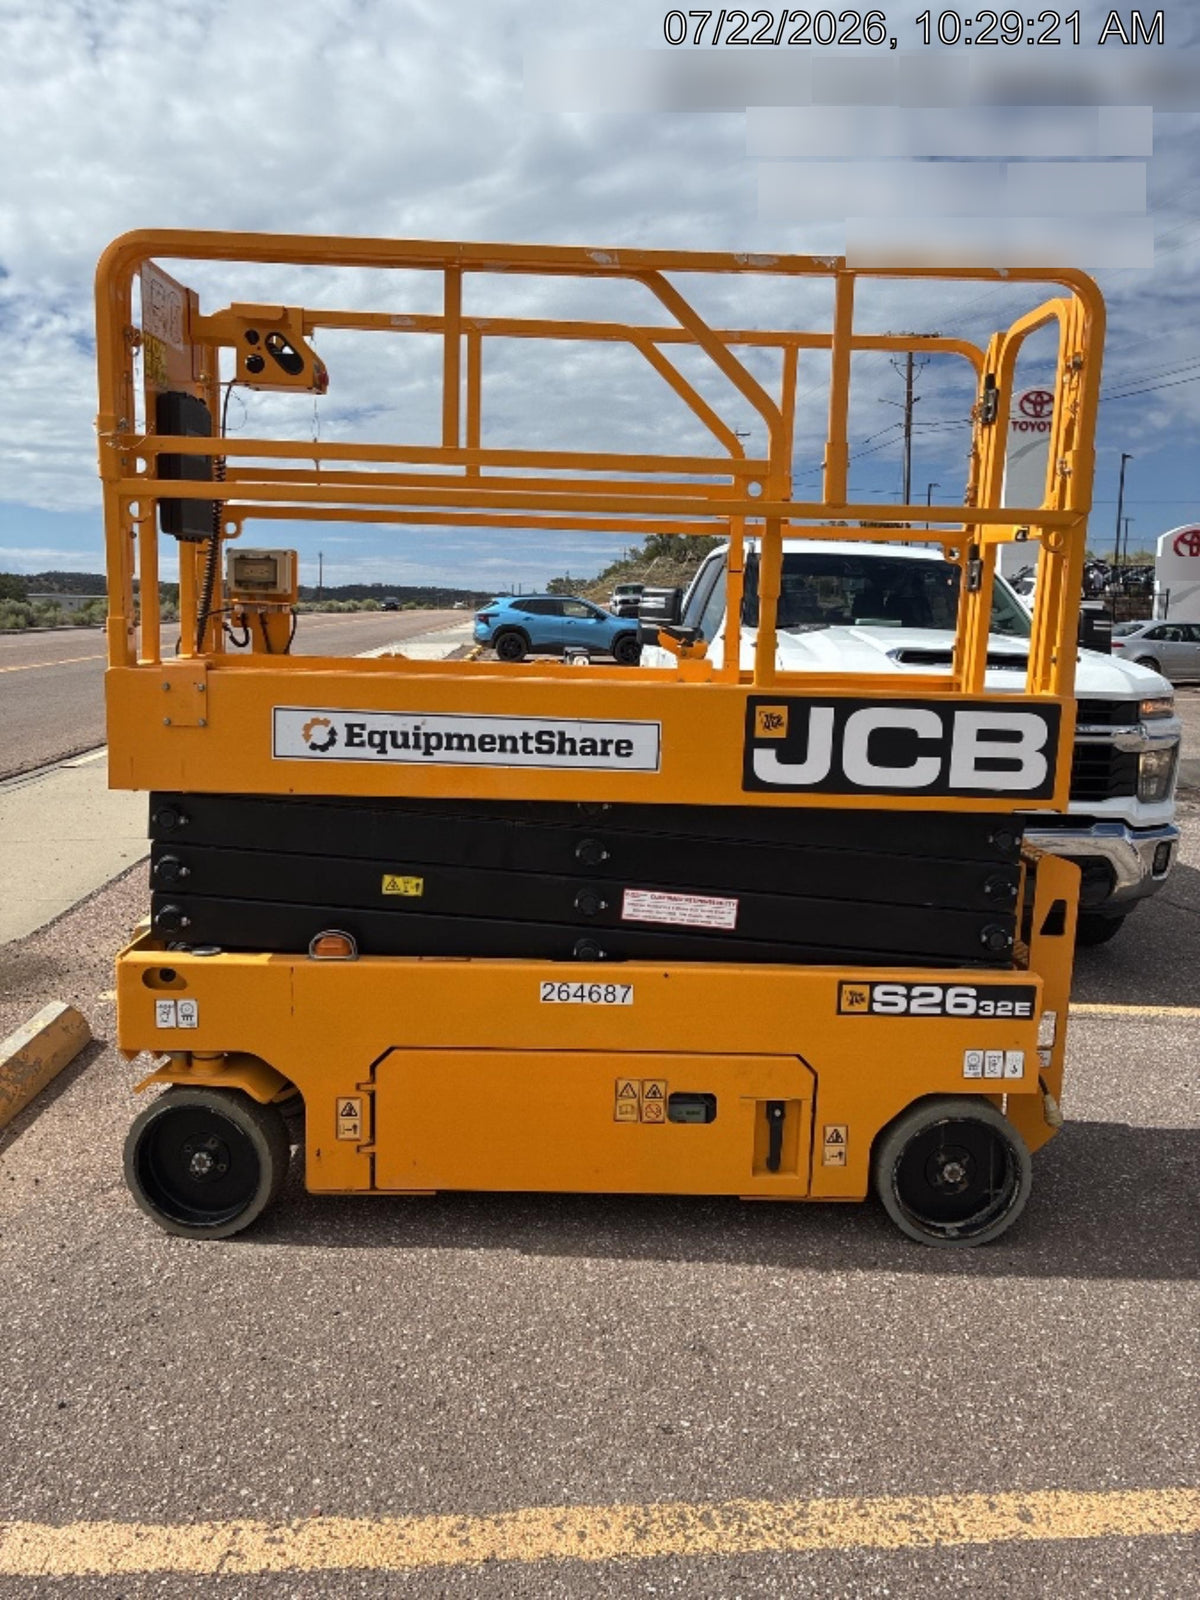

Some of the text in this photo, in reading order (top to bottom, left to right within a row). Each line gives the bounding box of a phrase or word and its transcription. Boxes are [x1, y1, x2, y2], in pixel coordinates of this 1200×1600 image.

[1011, 421, 1052, 432] TOYOT
[344, 723, 634, 759] EquipmentShare
[753, 706, 1048, 790] JCB
[542, 982, 632, 1004] 264687
